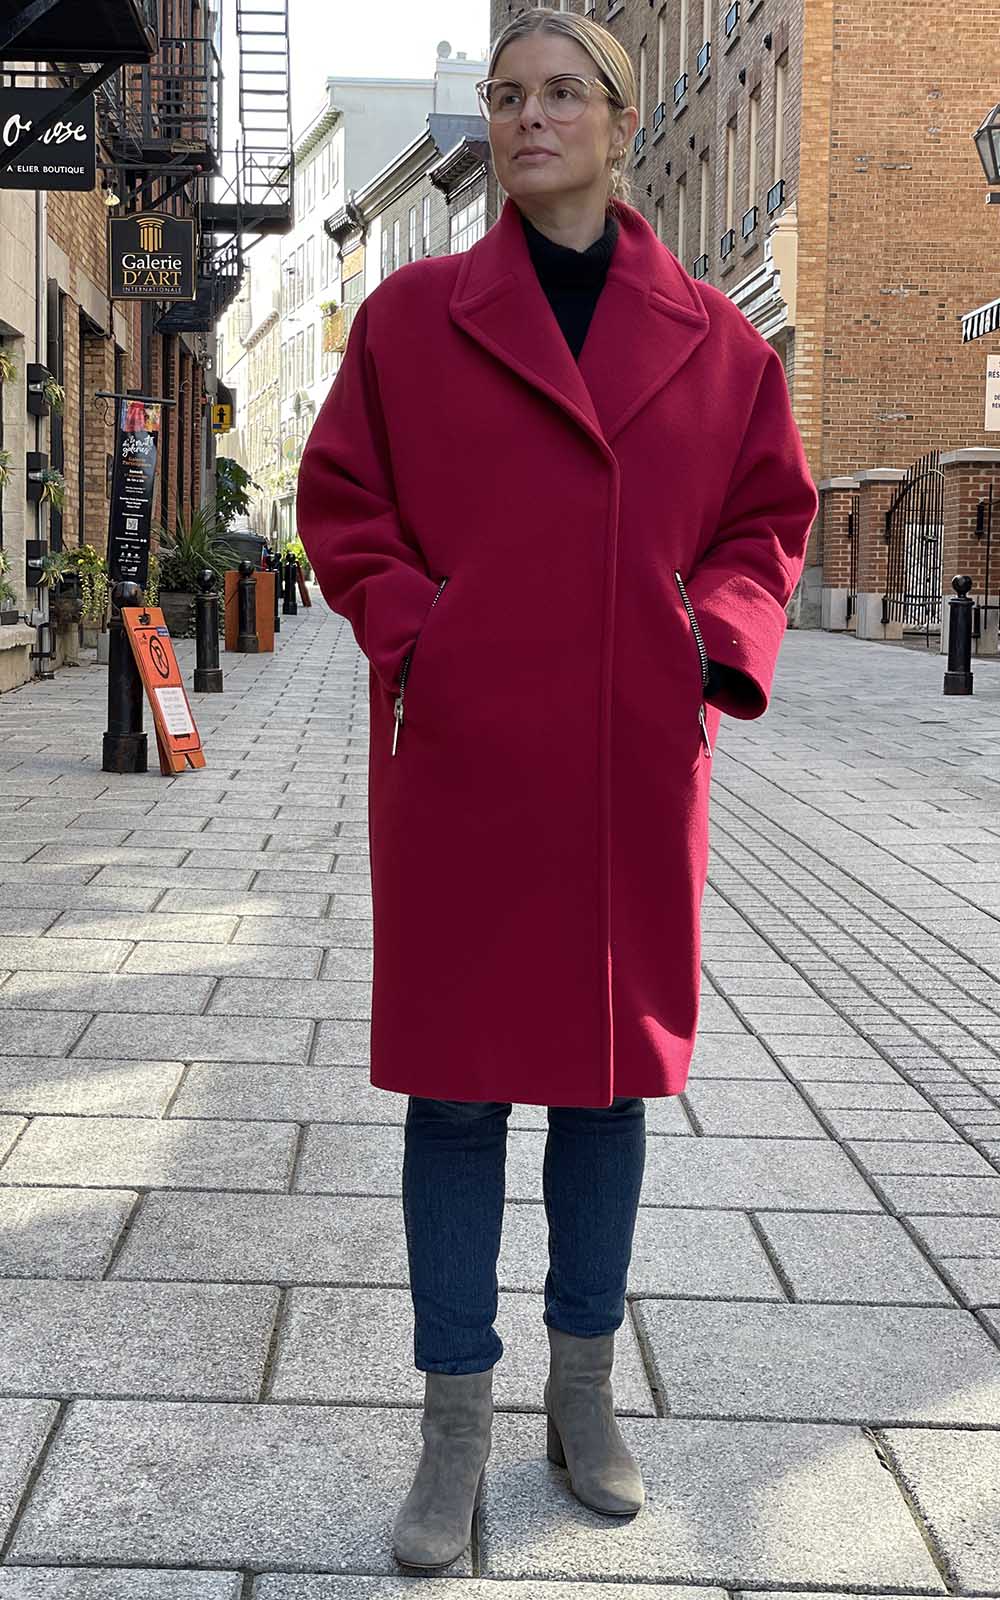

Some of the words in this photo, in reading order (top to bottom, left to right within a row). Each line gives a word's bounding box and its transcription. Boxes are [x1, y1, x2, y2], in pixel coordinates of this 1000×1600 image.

[6, 165, 40, 173] AELIER
[43, 165, 85, 174] BOUTIQUE
[122, 254, 182, 270] Galerie
[122, 270, 182, 286] D'ART
[122, 286, 182, 294] INTERNATIONALE
